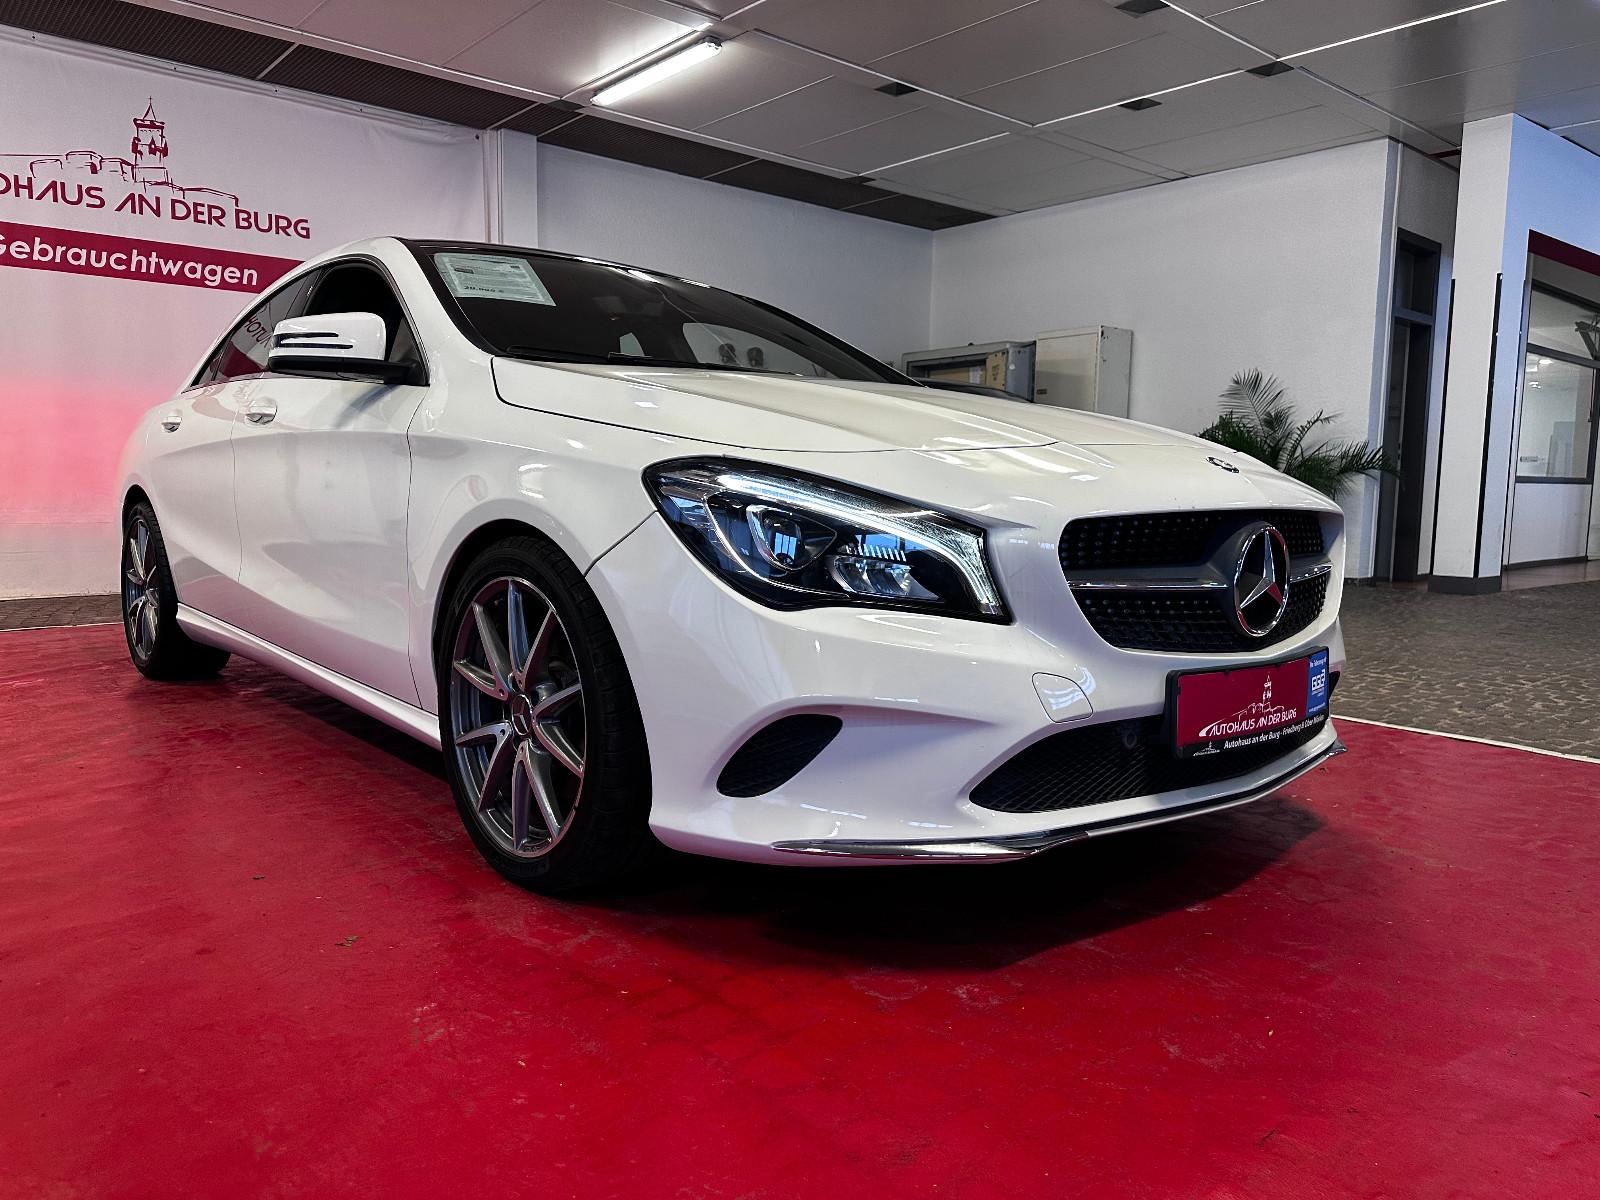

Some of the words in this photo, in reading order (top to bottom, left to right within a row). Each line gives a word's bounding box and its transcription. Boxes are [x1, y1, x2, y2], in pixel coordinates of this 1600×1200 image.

[115, 192, 161, 218] AN
[171, 198, 226, 227] DER
[235, 208, 311, 240] BURG
[1209, 718, 1256, 737] AUTOHAUS
[1256, 715, 1268, 728] AN
[1268, 712, 1281, 726] DER
[1281, 708, 1297, 722] BURG
[1223, 737, 1252, 750] Autohaus
[1252, 736, 1259, 744] an
[1259, 732, 1269, 742] der
[1268, 731, 1281, 740] Burg
